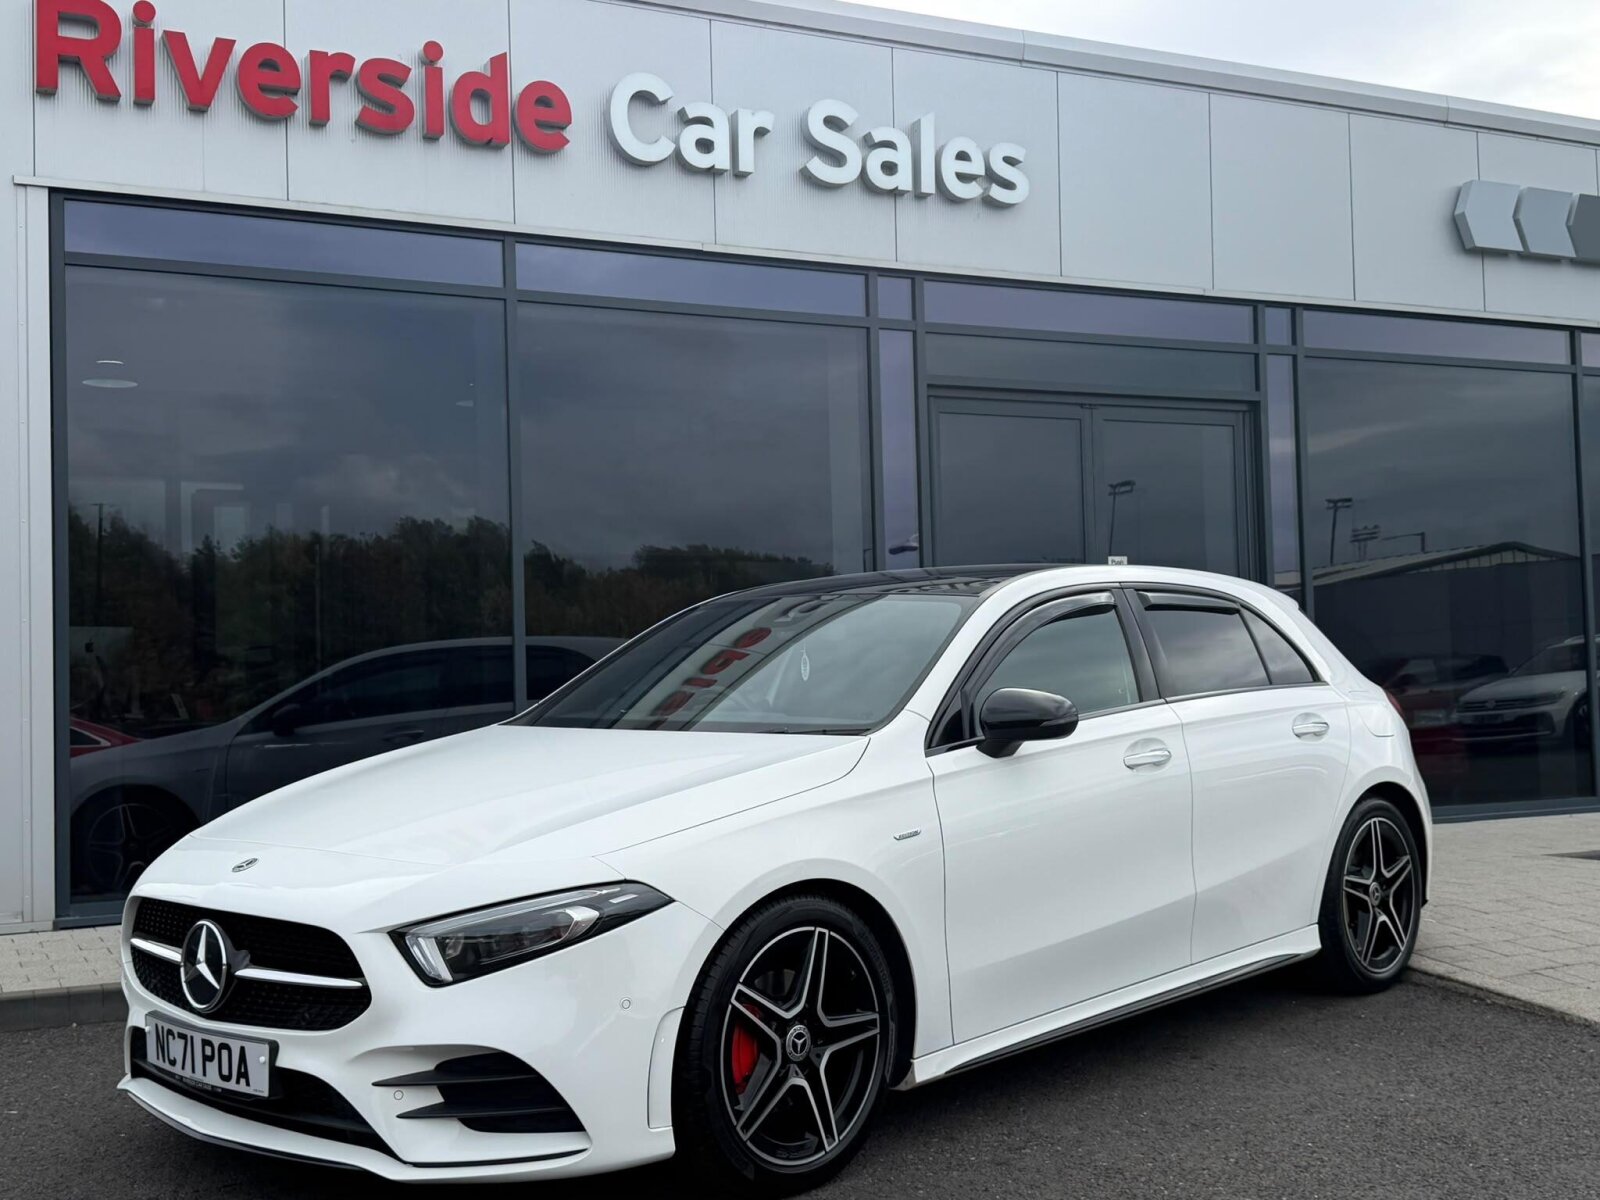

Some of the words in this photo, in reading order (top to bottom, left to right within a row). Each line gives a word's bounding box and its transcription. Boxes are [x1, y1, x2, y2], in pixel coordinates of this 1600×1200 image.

[35, 0, 572, 154] Riverside
[607, 71, 775, 178] Car
[800, 98, 1031, 208] Sales
[154, 1022, 196, 1074] NC71
[200, 1037, 251, 1087] POA
